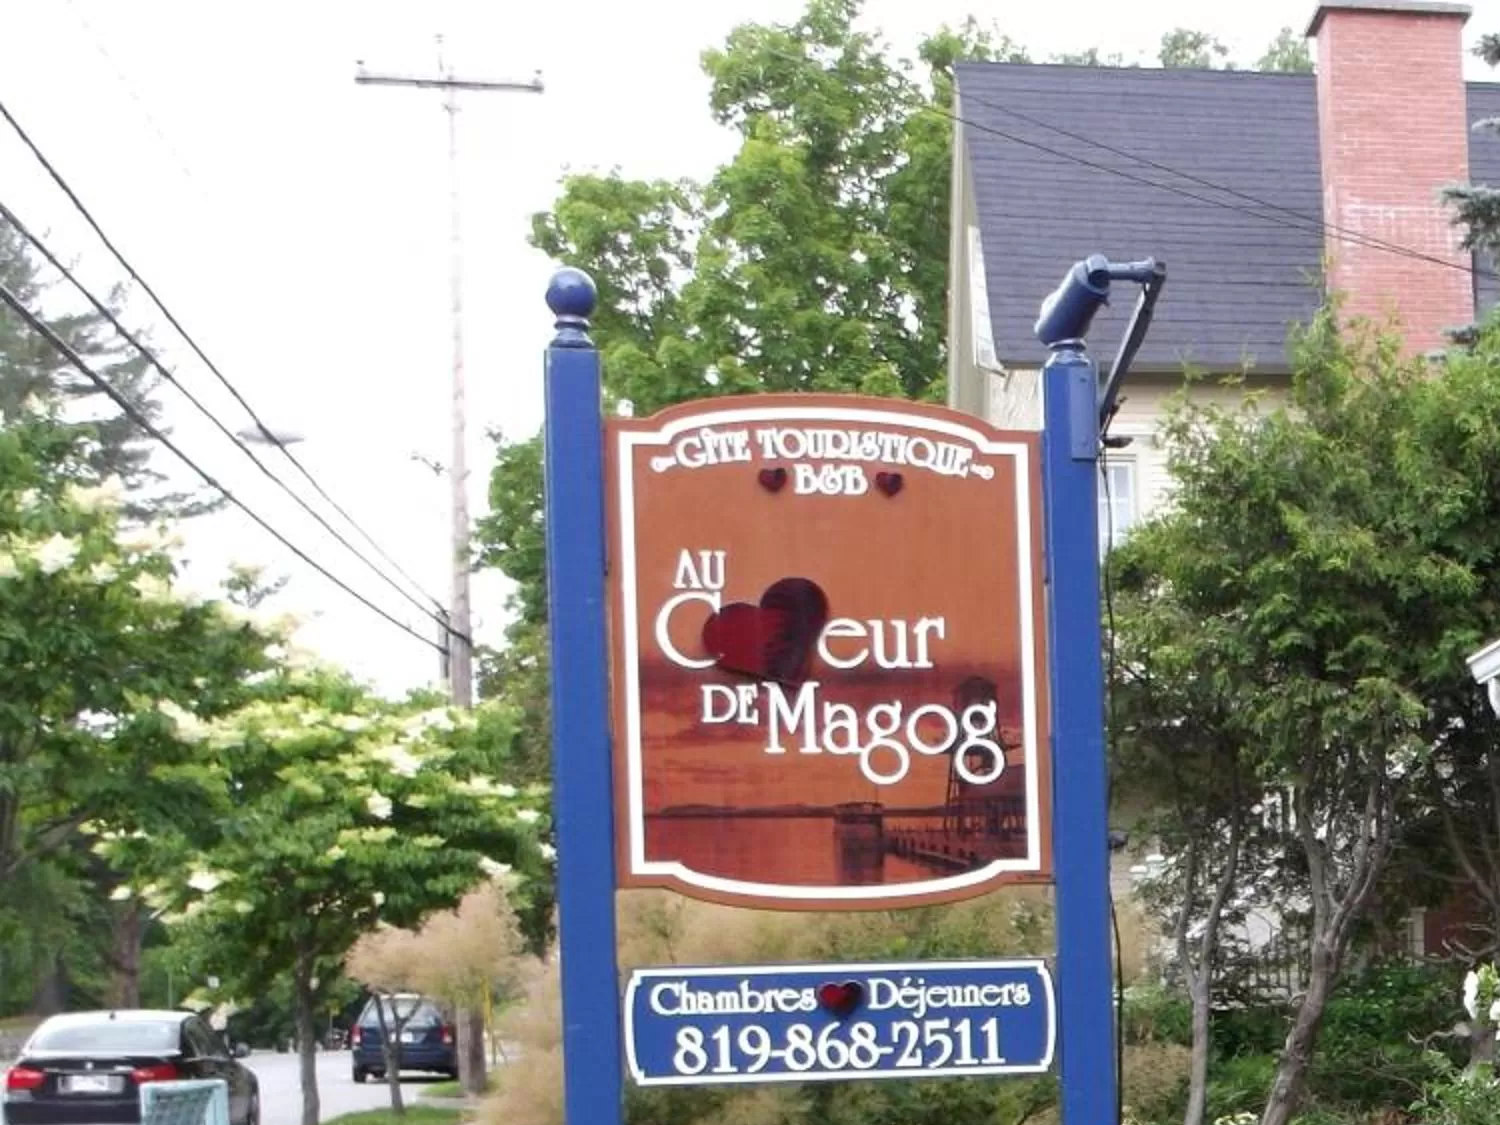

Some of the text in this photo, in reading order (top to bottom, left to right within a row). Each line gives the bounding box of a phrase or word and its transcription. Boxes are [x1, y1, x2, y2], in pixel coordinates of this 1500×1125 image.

[757, 427, 973, 478] TOURISTIQUE
[794, 464, 869, 495] B&B
[673, 549, 727, 590] AU
[701, 681, 1005, 785] DE Magog
[650, 978, 1031, 1018] Chambres Déjeuners
[673, 1017, 1006, 1074] 819-868-2511
